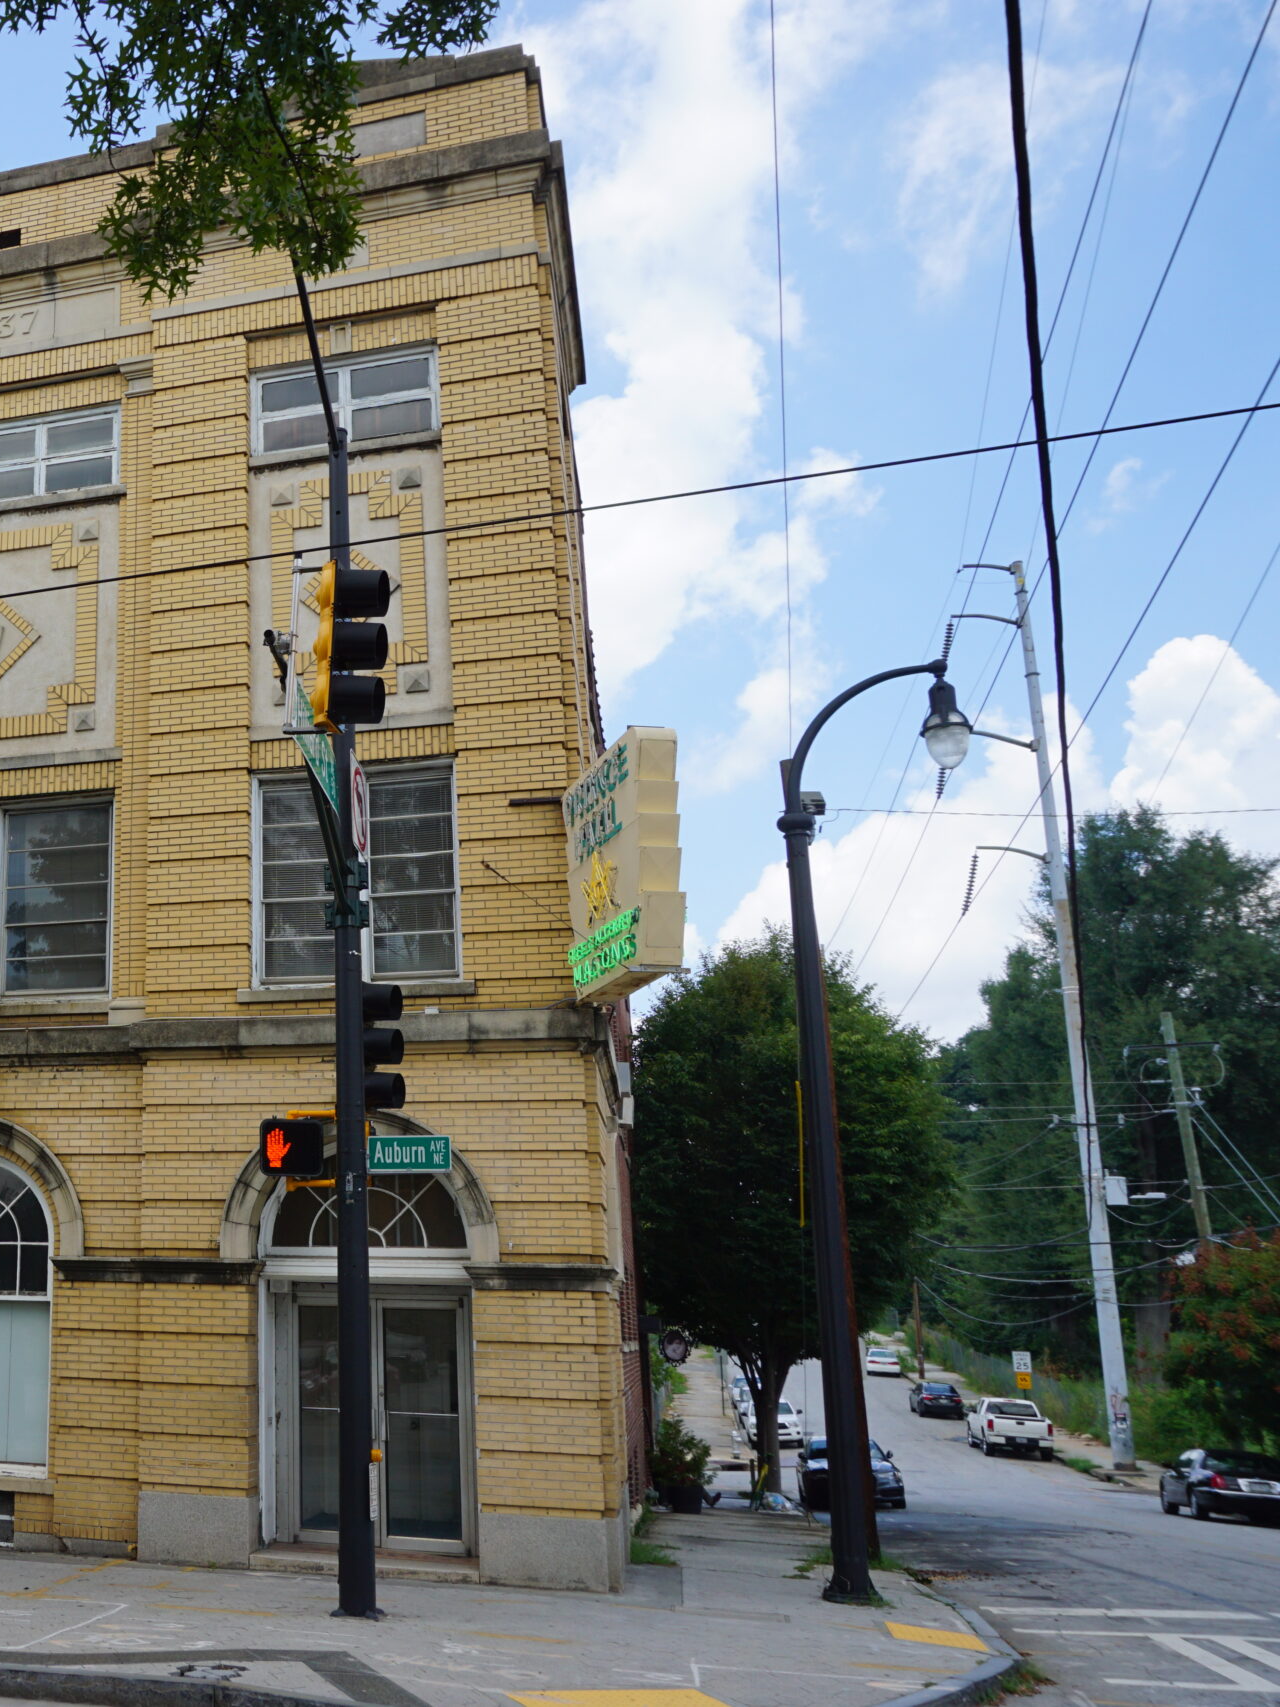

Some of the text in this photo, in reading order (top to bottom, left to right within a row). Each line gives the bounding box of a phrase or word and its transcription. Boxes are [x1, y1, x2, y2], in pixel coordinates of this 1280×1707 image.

[575, 798, 623, 864] HALL
[574, 933, 637, 989] MASONS
[374, 1140, 446, 1164] Auburn AVE
[433, 1152, 445, 1164] NE
[1016, 1361, 1030, 1370] 25
